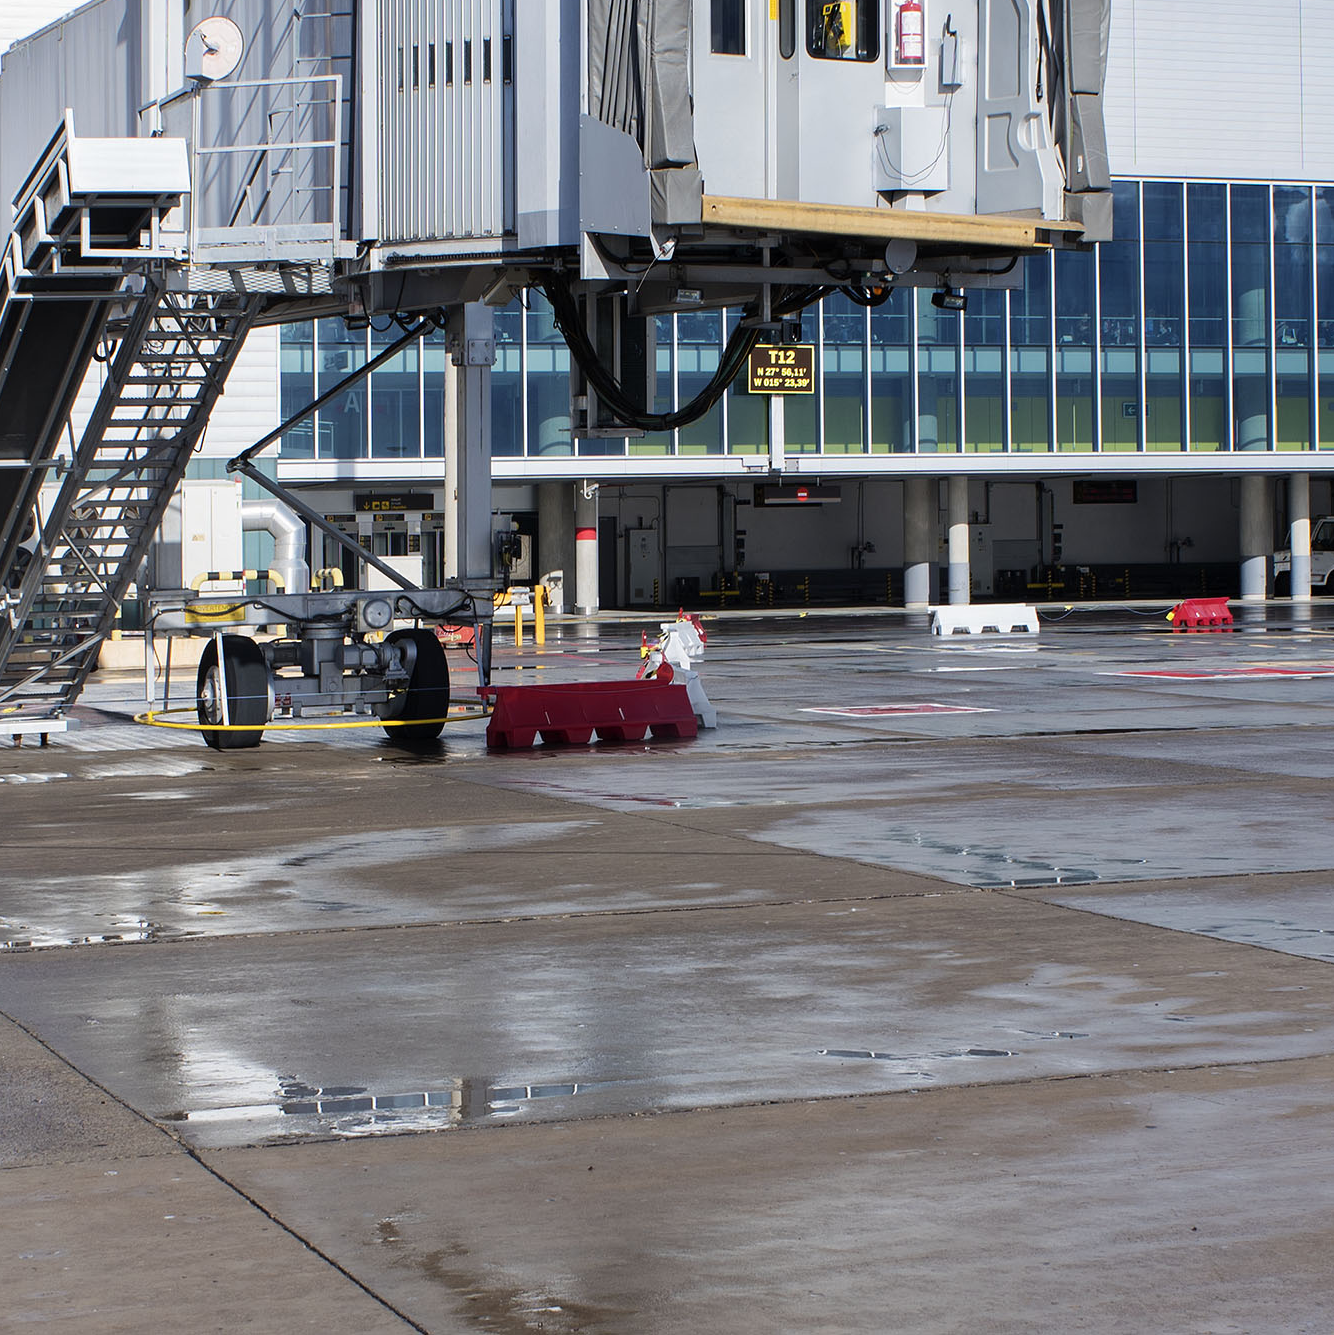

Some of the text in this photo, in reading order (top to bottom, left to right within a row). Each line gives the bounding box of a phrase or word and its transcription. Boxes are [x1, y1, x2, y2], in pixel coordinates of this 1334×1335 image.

[768, 350, 796, 364] T12
[757, 367, 764, 376] N
[765, 367, 780, 376] 27°
[753, 378, 763, 387] W
[344, 392, 360, 413] A
